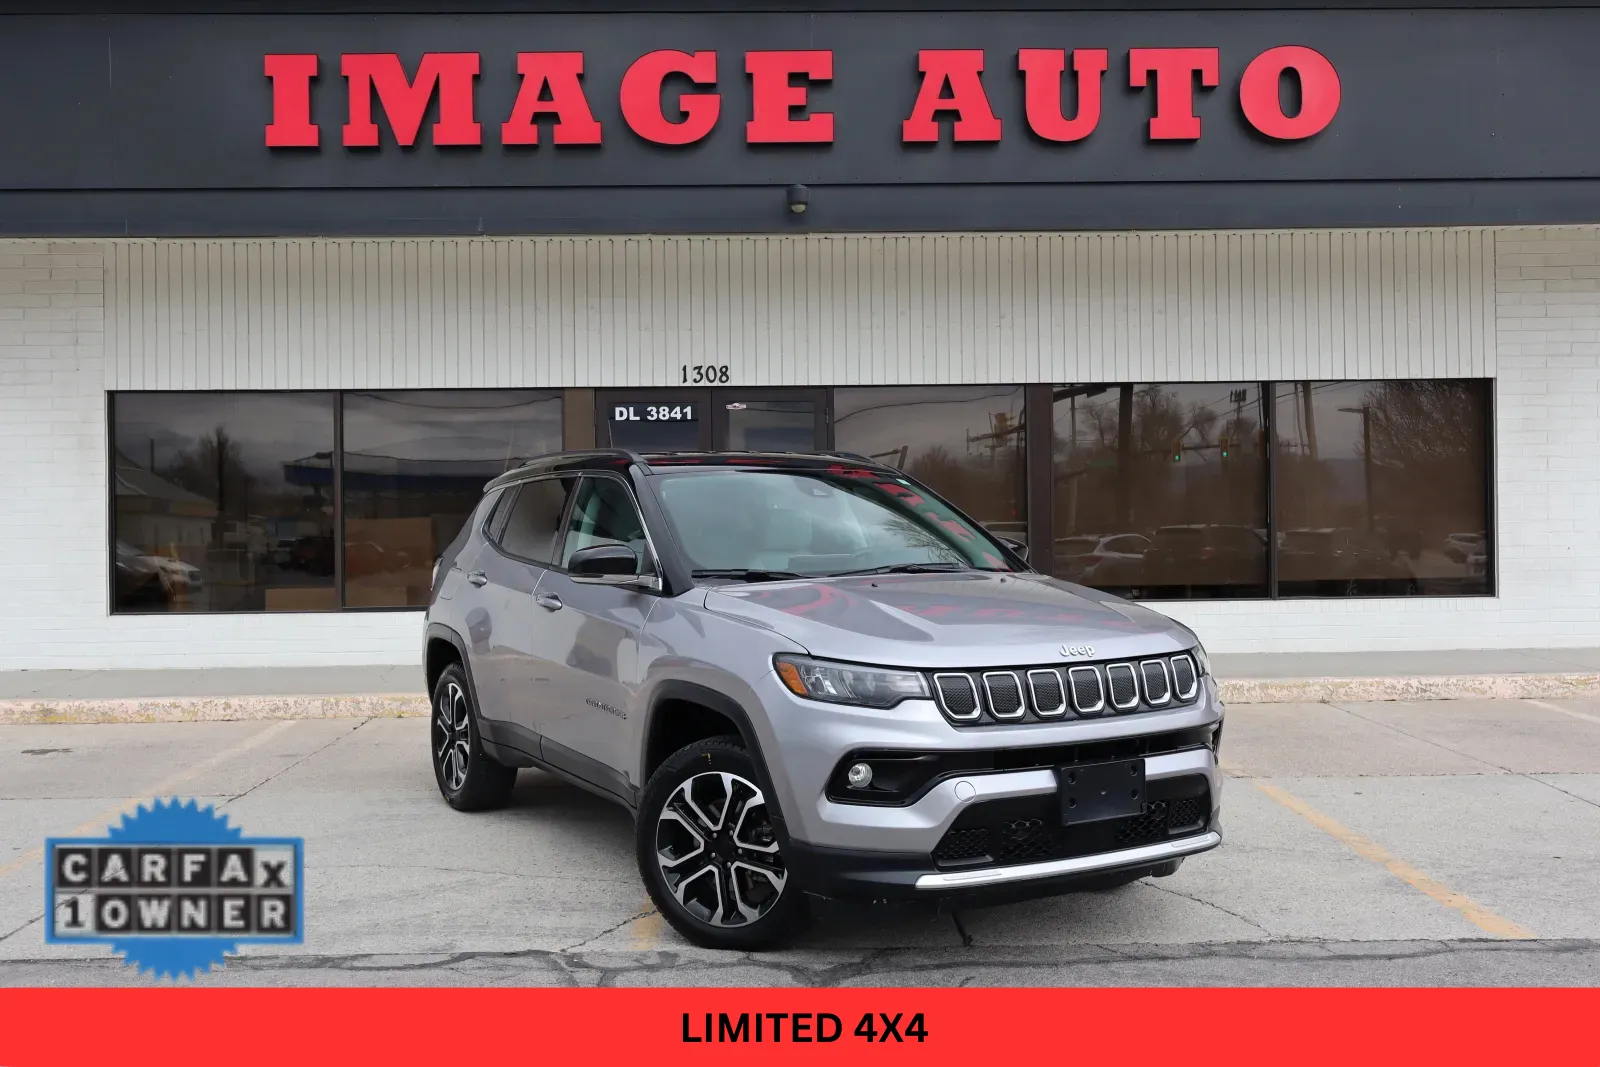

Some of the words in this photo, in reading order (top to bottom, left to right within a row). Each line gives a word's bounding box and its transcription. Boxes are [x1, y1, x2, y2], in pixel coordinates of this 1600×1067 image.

[264, 49, 834, 147] IMAGE
[902, 45, 1341, 142] AUTO
[682, 365, 730, 383] 1308
[615, 406, 640, 421] DL
[646, 406, 692, 420] 3841
[1060, 644, 1095, 657] Jeep
